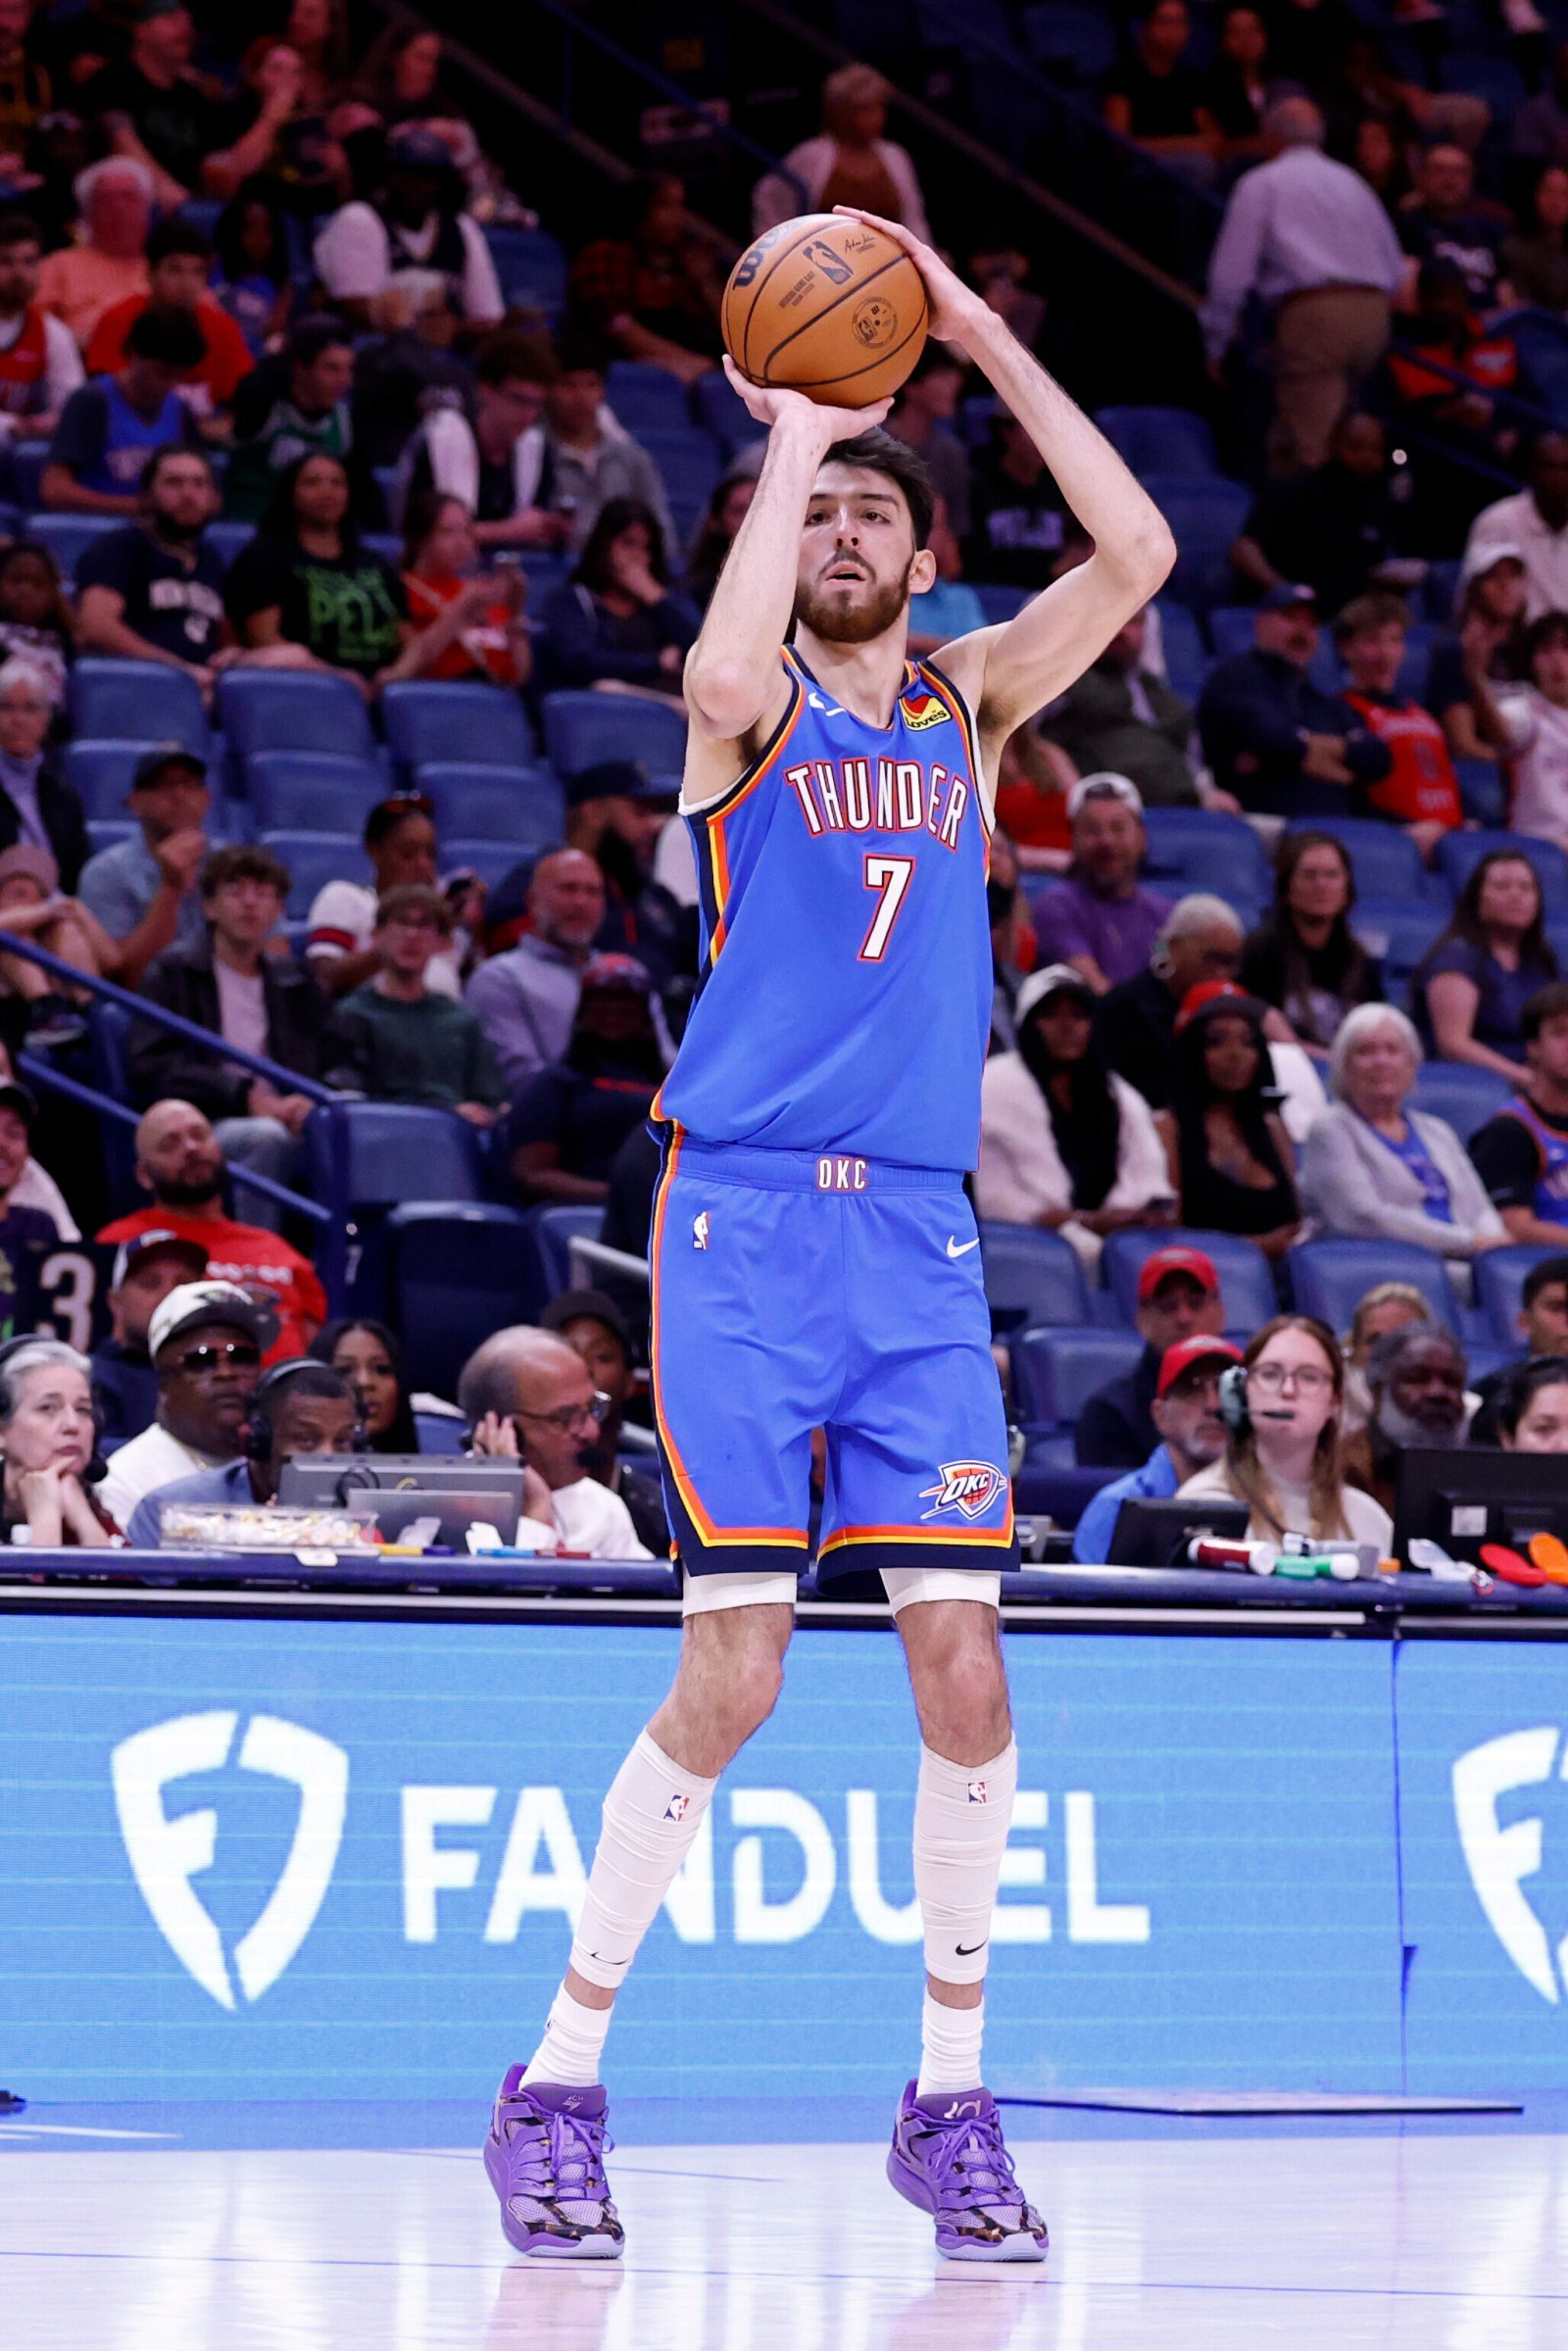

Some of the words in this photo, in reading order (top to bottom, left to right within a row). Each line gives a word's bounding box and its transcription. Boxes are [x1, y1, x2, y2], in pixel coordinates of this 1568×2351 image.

[784, 757, 969, 853] THUNDER
[857, 853, 916, 963] 7
[816, 1155, 868, 1192] OKC
[38, 1251, 97, 1356] 3
[939, 1472, 991, 1505] OKC
